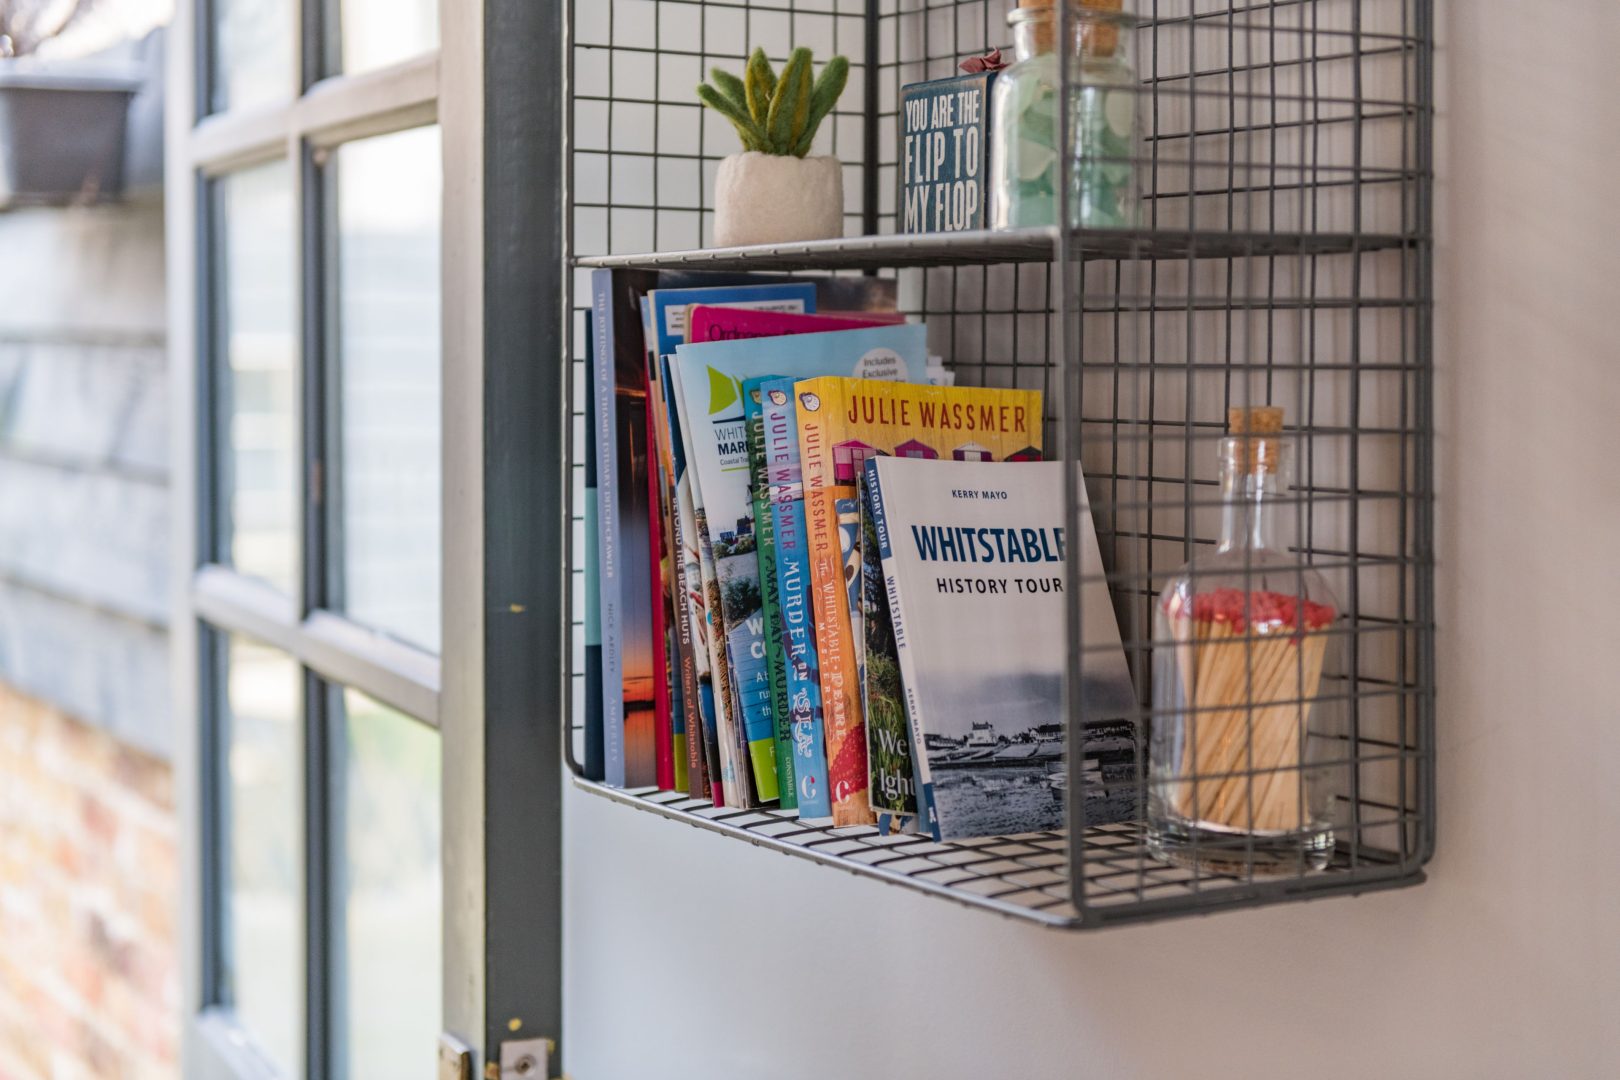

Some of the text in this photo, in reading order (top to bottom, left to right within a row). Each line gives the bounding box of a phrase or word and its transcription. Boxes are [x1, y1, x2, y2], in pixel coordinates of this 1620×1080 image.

[905, 89, 980, 133] YOU ARE THE
[904, 125, 979, 184] FLIP TO
[904, 179, 978, 234] MY FLOP
[862, 368, 898, 379] Exclusive
[863, 356, 897, 367] Includes
[715, 426, 746, 441] WHIT
[848, 395, 1027, 433] JULIE WASSMER
[720, 457, 740, 466] Coastal
[752, 411, 775, 547] JULIE WASSMER
[770, 412, 796, 550] JULIE WASSMER
[804, 423, 828, 552] JULIE WASSMER
[868, 469, 888, 549] HISTORY TOUR
[951, 489, 1008, 500] KERRY MAYO
[676, 549, 686, 571] THE
[936, 577, 1064, 594] HISTORY TOUR
[678, 572, 688, 612] BEACH
[783, 557, 807, 660] MURDER
[797, 663, 808, 681] ON
[886, 575, 906, 650] WHITSTABLE
[680, 614, 690, 645] HUTS
[822, 579, 841, 664] WHITSTABLE
[818, 622, 832, 705] MYSTERY
[683, 655, 698, 769] Writers of Whitstable
[831, 672, 847, 739] PEARL
[907, 688, 922, 744] KERRY MAYO
[785, 756, 794, 798] CONSTABLE
